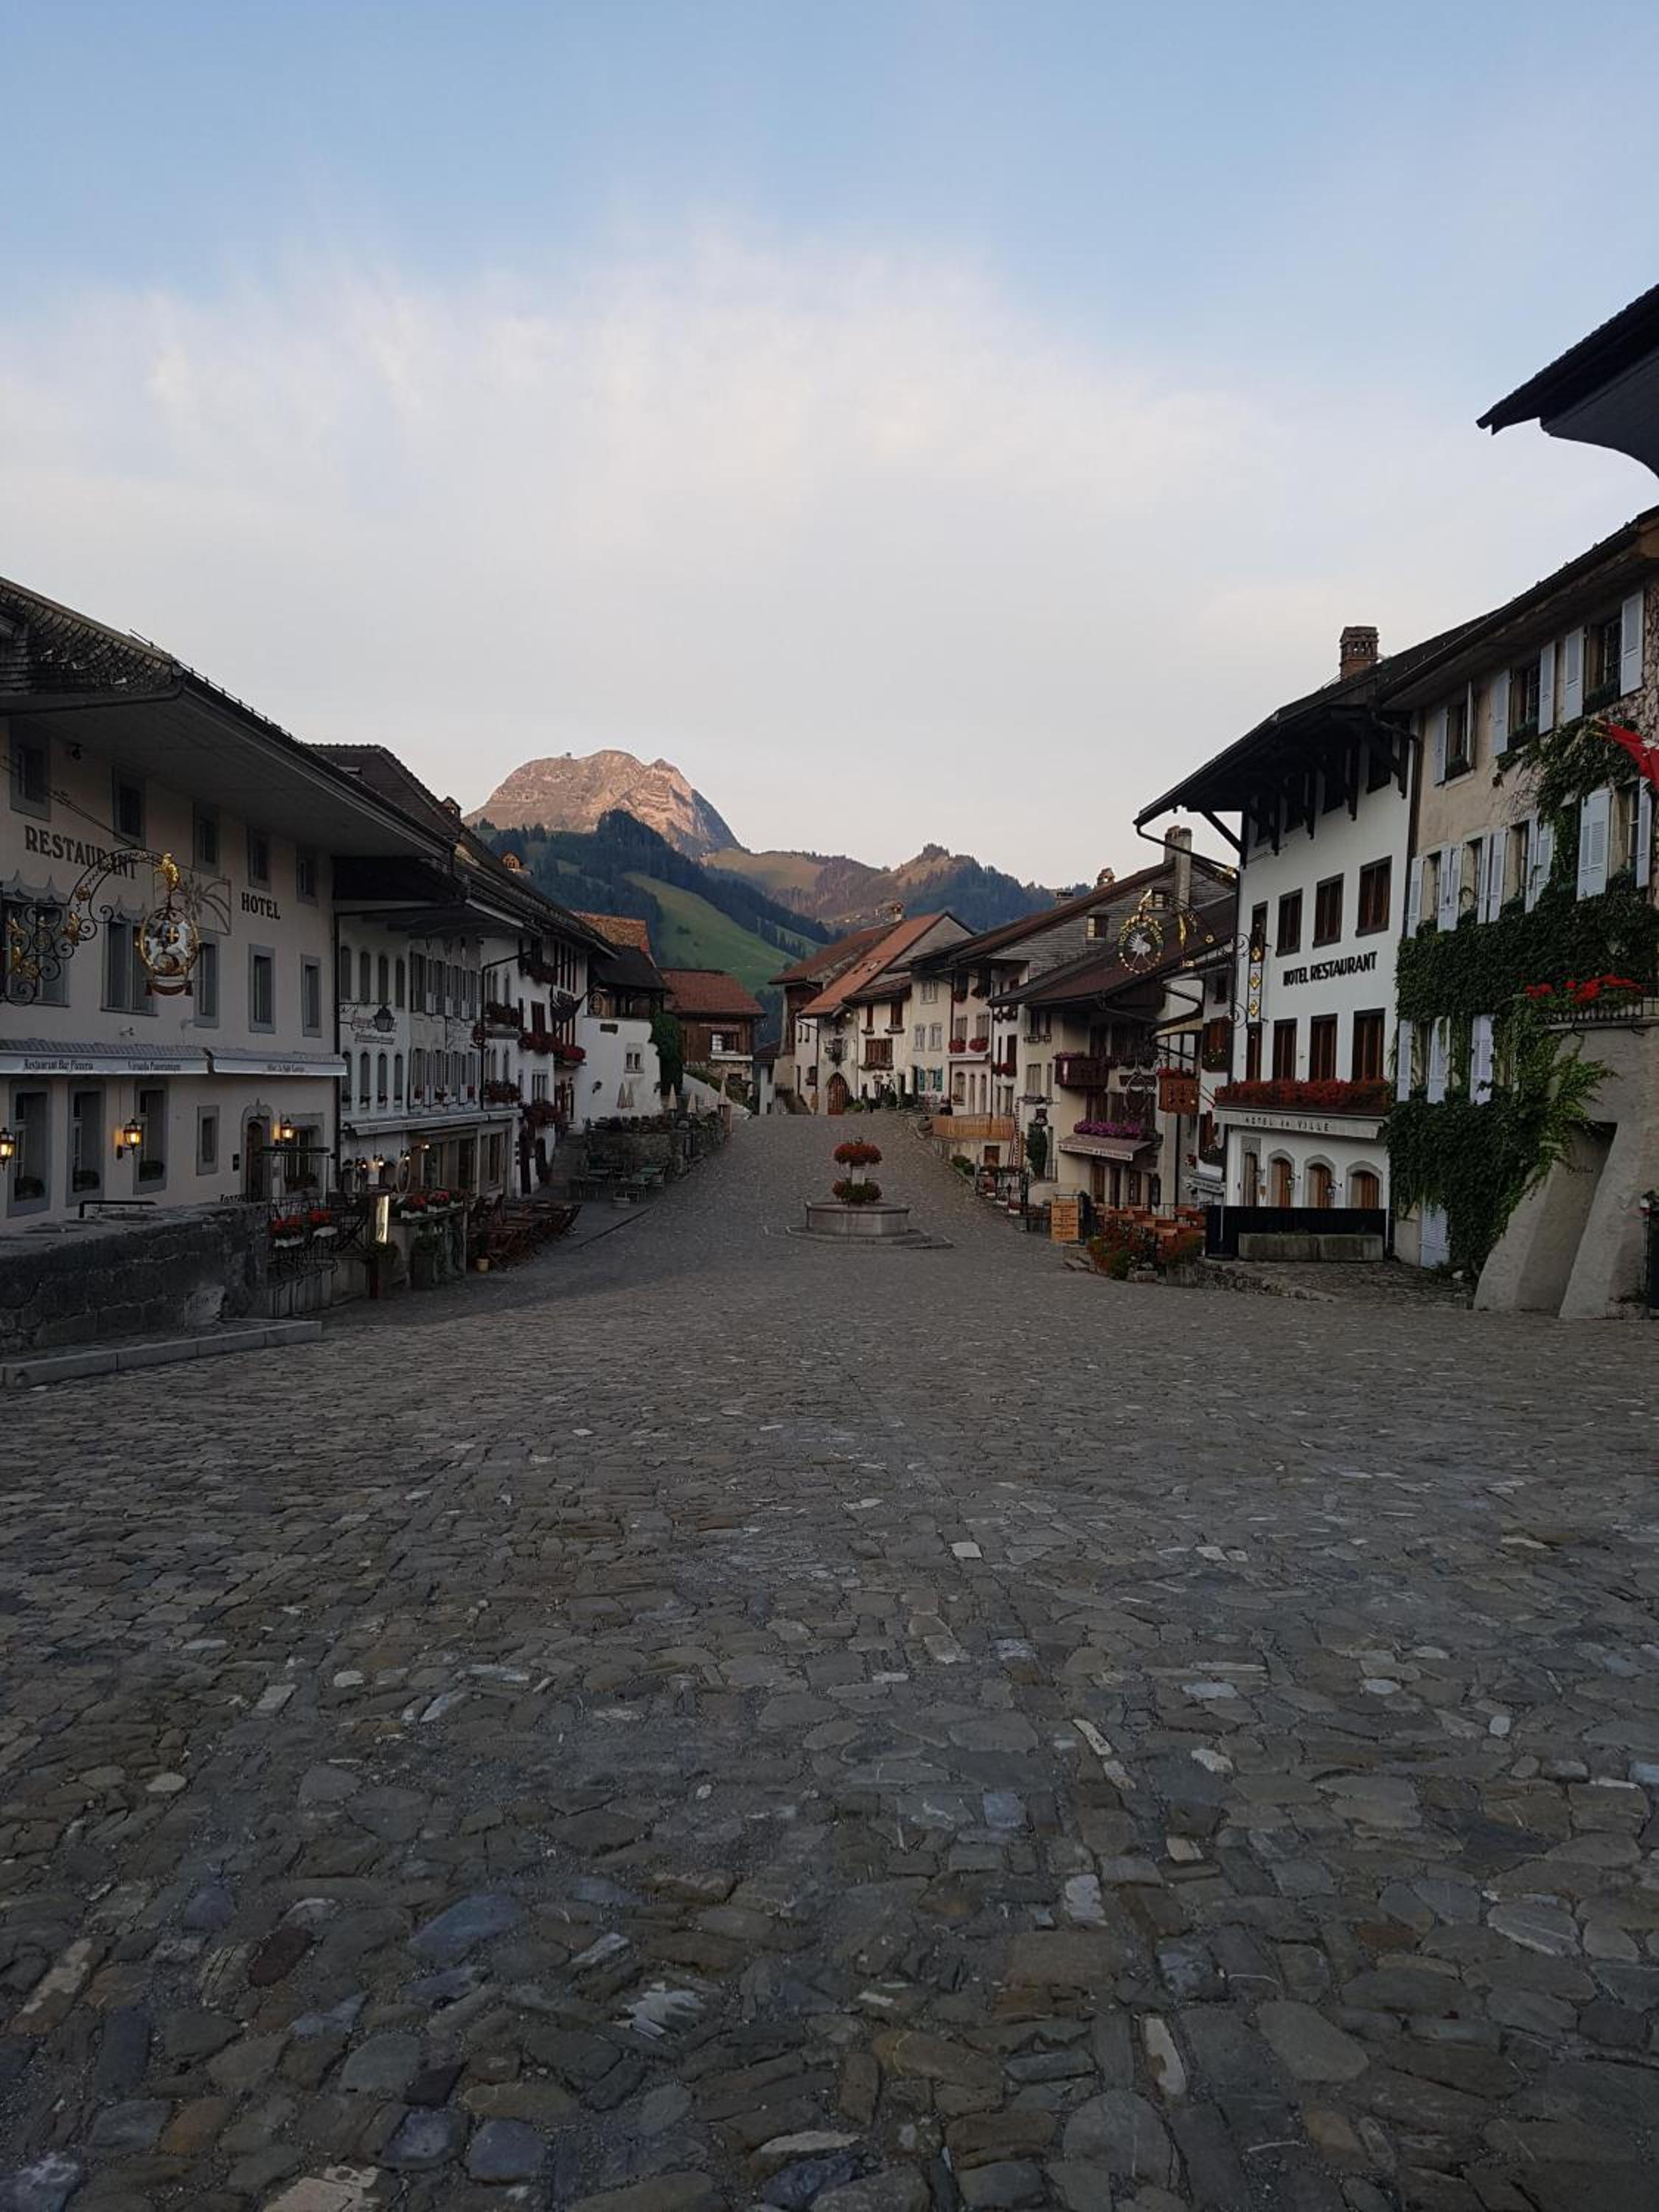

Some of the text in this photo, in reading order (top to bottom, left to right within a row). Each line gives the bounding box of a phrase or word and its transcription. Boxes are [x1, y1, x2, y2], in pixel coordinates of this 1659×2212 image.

[24, 825, 136, 880] RESTAURANT
[241, 892, 280, 920] HOTEL
[1282, 950, 1377, 985] HOTEL RESTAURANT
[1297, 1119, 1329, 1131] VILLE
